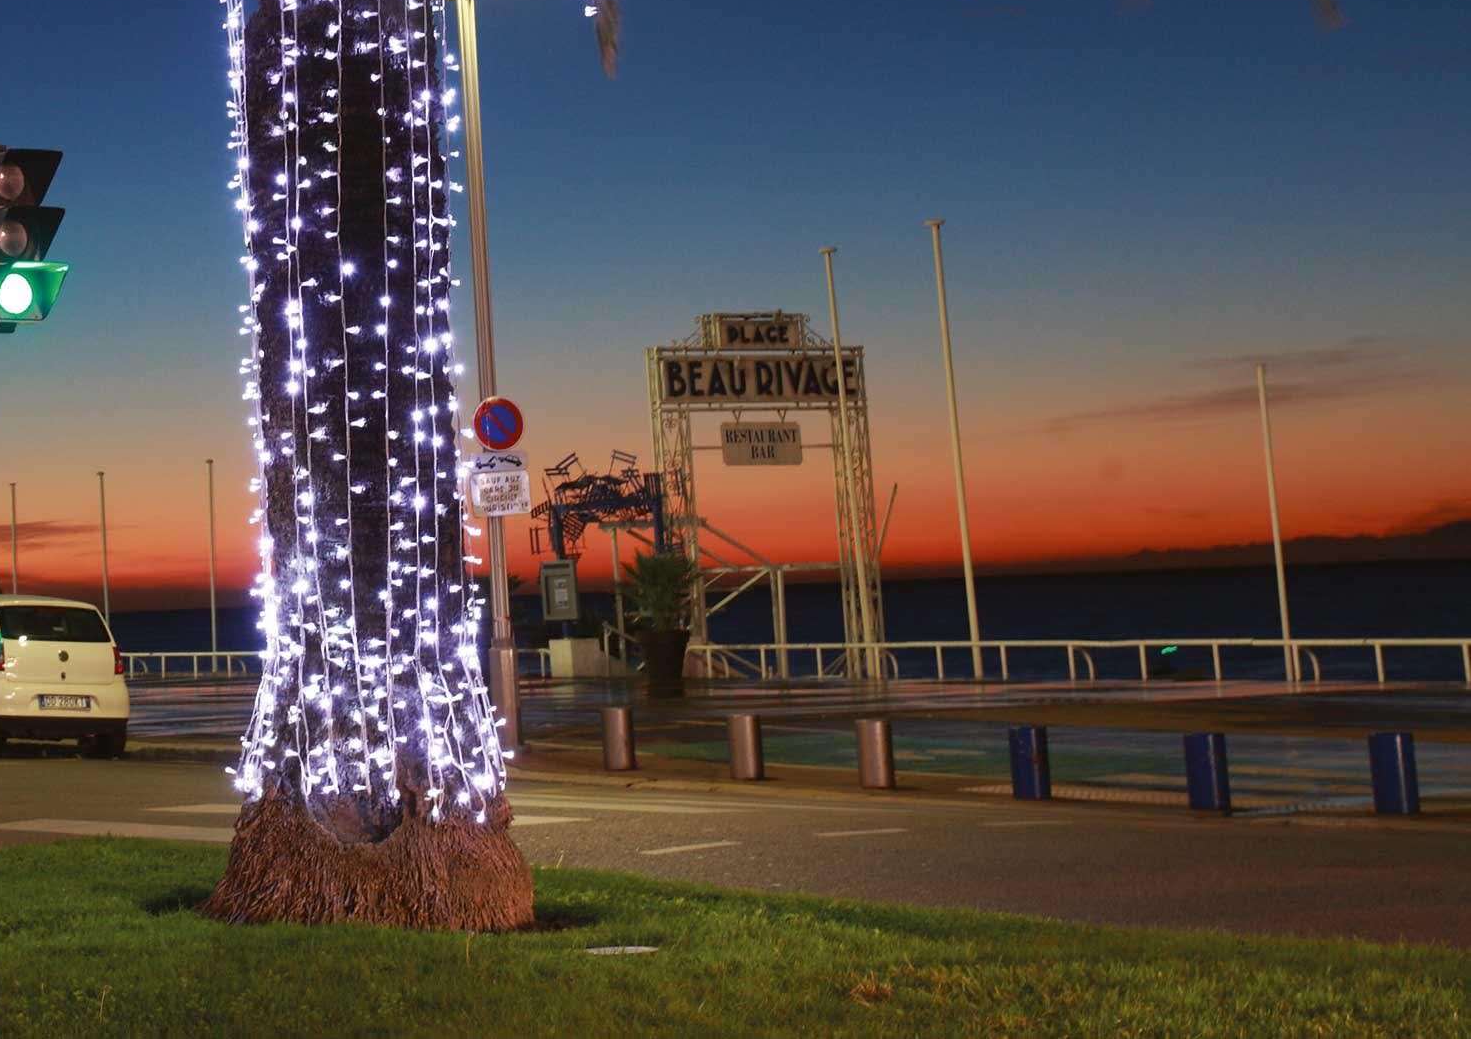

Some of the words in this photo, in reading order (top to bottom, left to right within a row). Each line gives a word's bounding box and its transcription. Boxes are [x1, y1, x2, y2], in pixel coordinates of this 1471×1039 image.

[727, 324, 789, 344] PLACE
[666, 361, 747, 397] BEAU
[755, 360, 857, 396] RIVAGE
[725, 429, 797, 444] RESTAURANT
[751, 444, 776, 459] BAR
